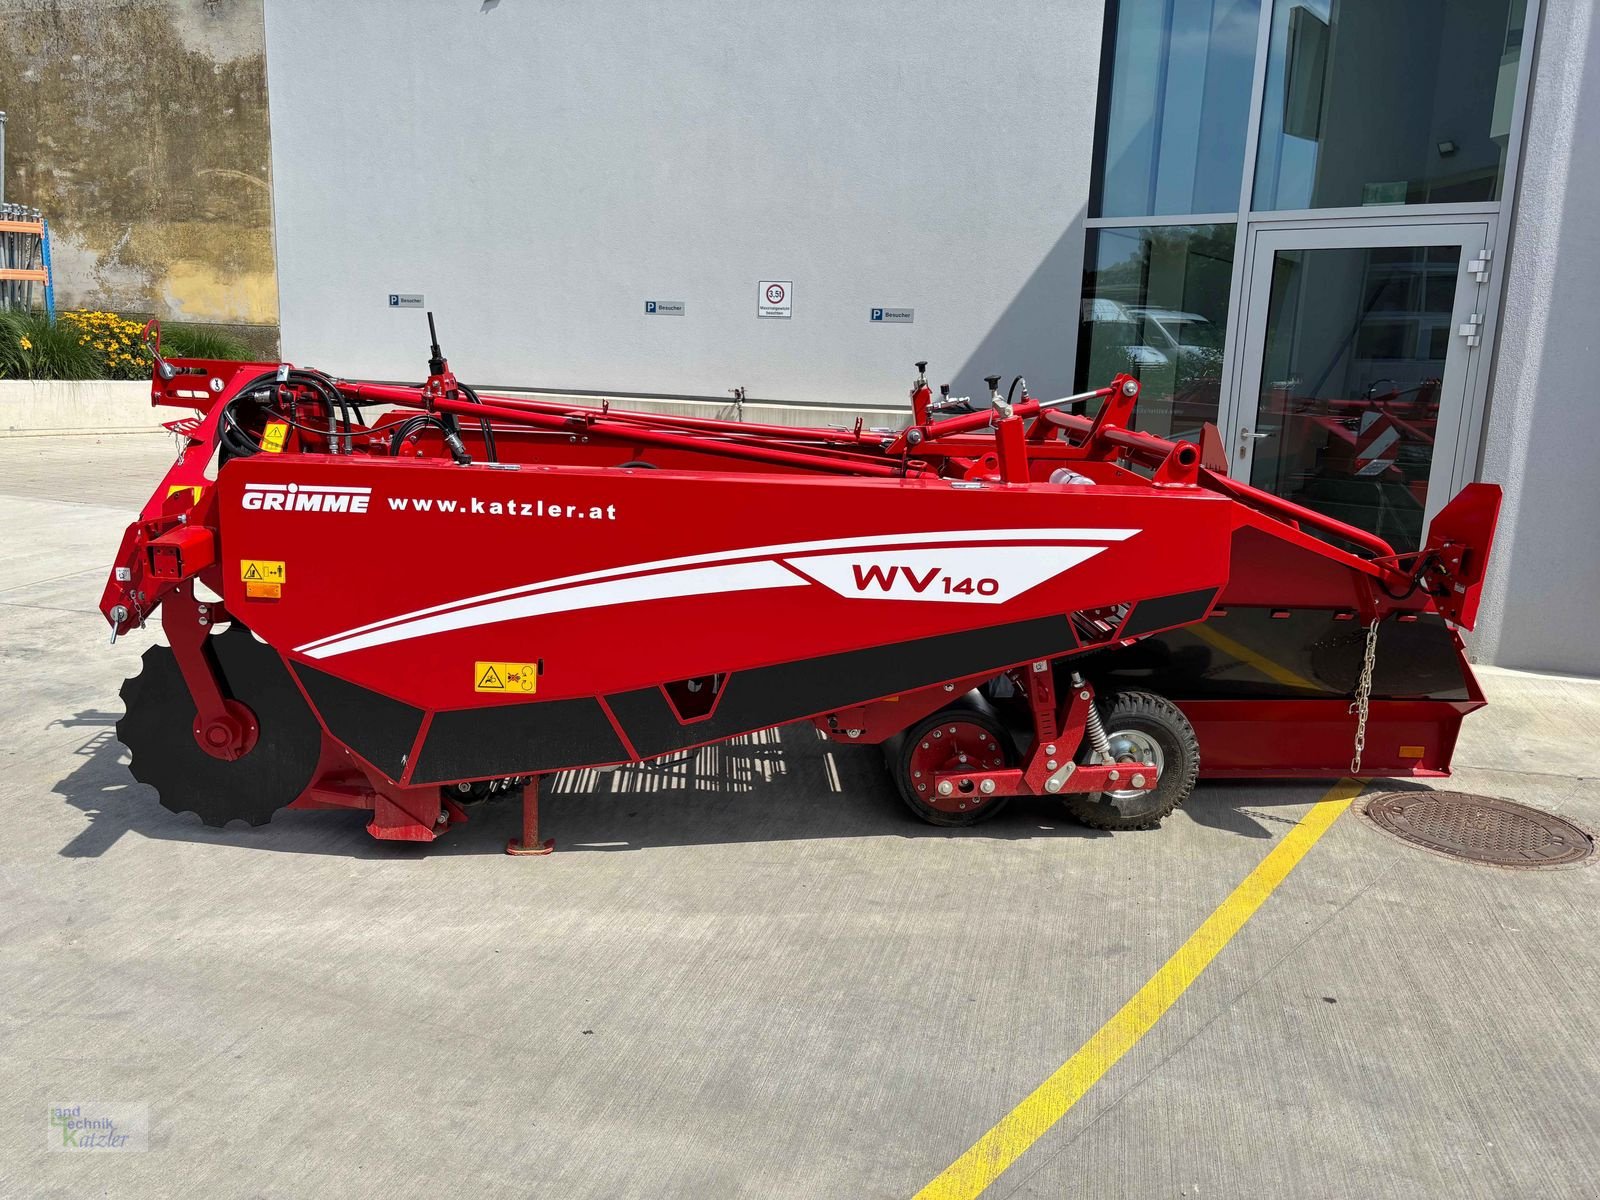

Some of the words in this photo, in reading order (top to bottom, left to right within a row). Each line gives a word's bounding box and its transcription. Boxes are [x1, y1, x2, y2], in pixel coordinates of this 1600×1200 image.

[391, 295, 398, 305] P
[647, 302, 655, 312] P
[873, 309, 881, 320] P
[241, 484, 371, 514] GRIMME
[387, 497, 617, 521] www.katzler.at
